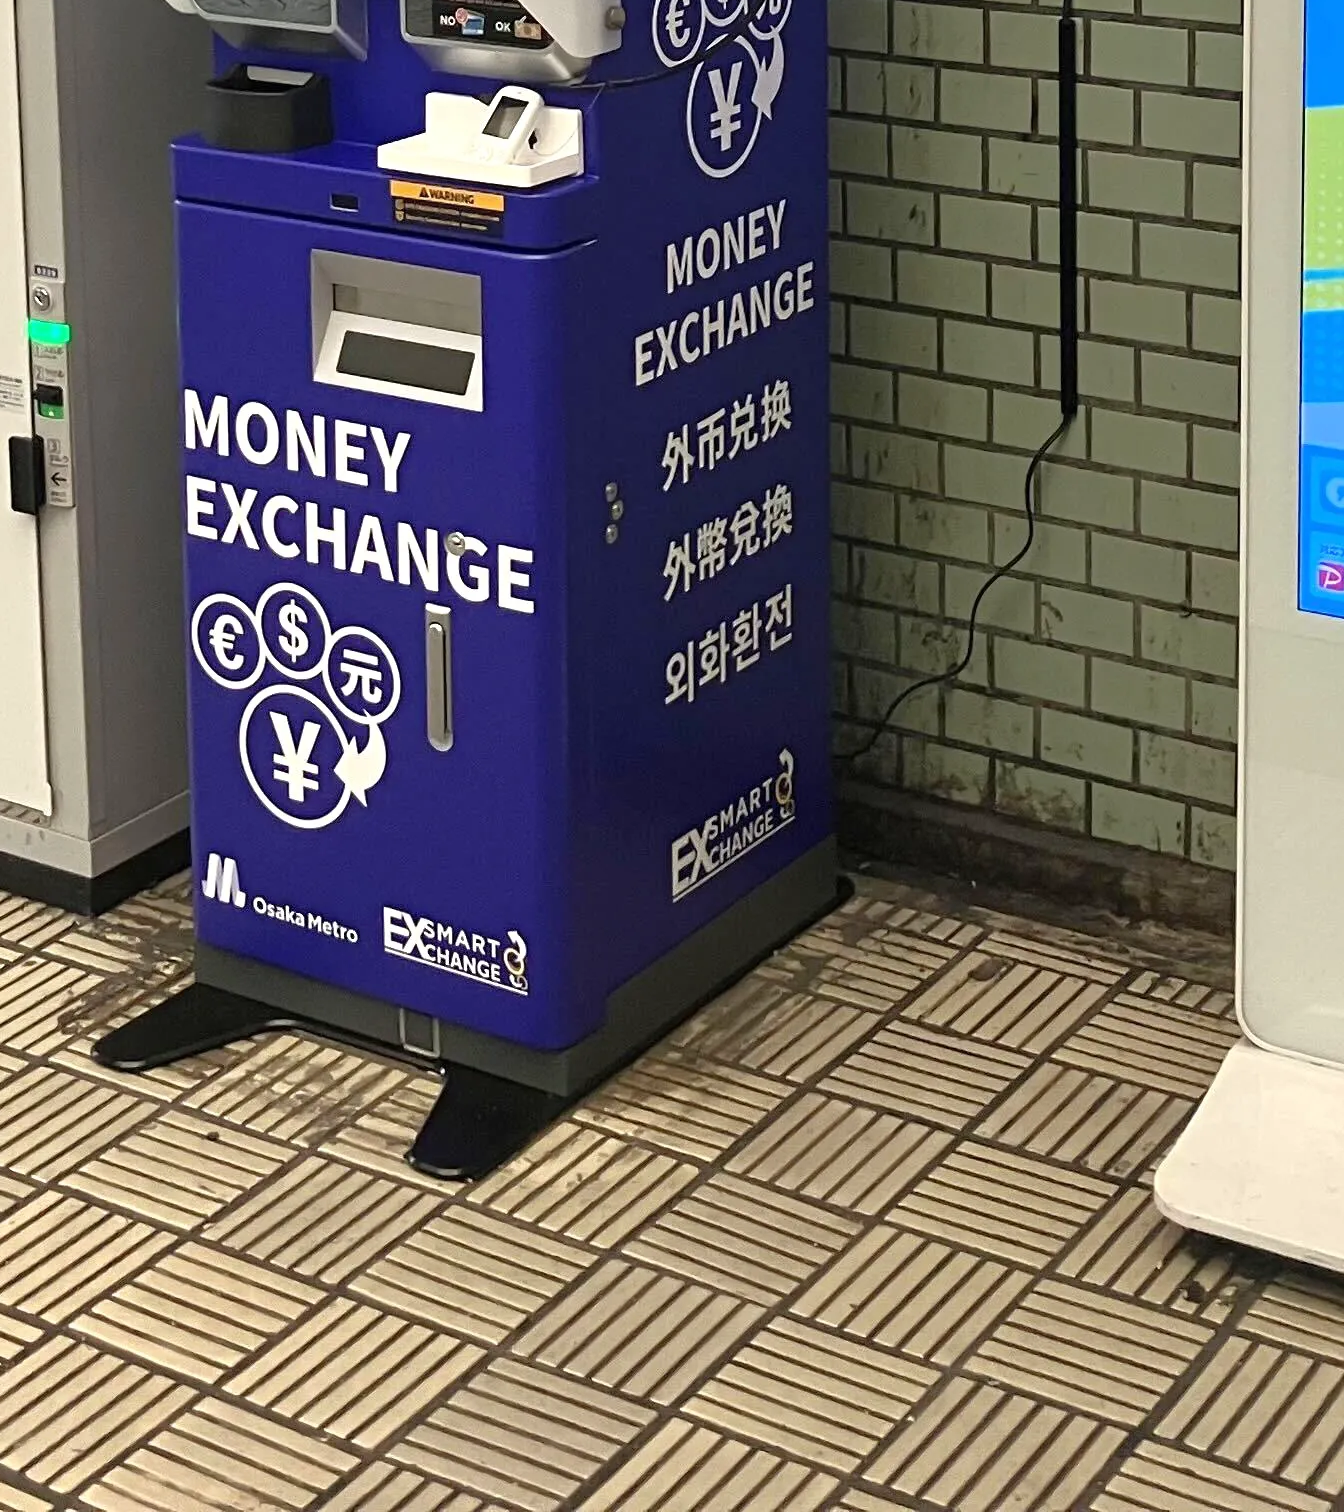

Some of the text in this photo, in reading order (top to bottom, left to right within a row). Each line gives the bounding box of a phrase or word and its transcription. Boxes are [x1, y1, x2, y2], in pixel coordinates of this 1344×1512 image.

[440, 15, 511, 32] NO OK
[428, 189, 474, 204] WARNING
[665, 199, 788, 295] MONEY
[634, 260, 815, 386] EXCHANGE
[184, 389, 412, 493] MONEY
[660, 379, 792, 492] 外币兑换
[186, 474, 535, 614] EXCHANGE
[664, 584, 795, 705] 외화환전
[710, 777, 772, 845] SMART
[253, 895, 358, 943] Osaka Metro
[423, 918, 500, 960] SMART
[423, 944, 501, 982] CHANGE
